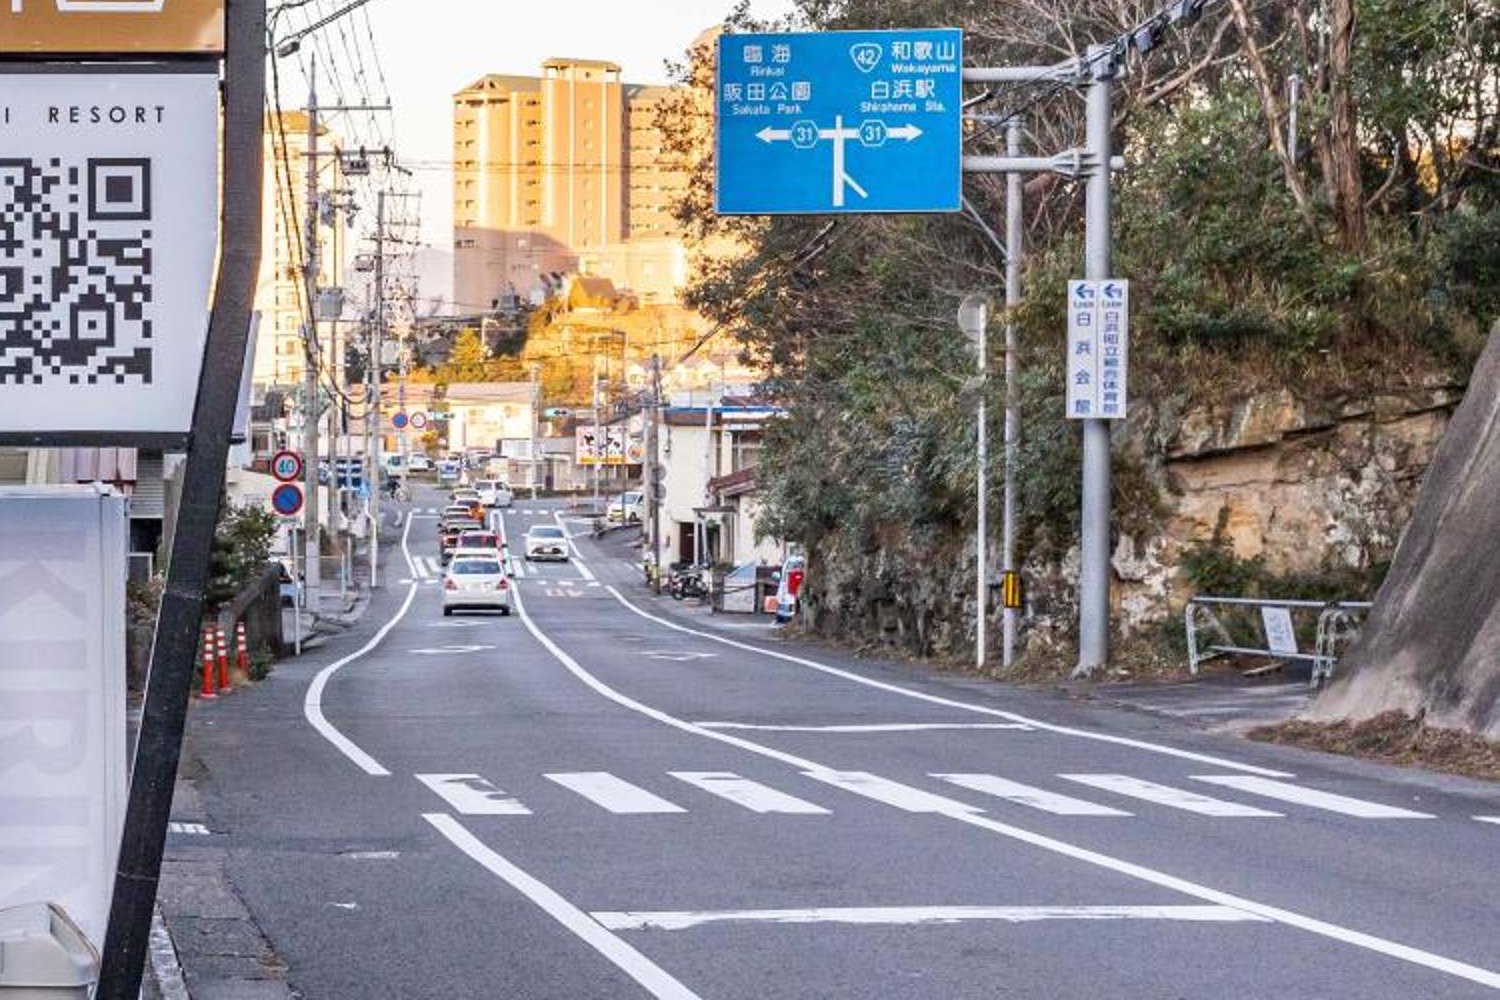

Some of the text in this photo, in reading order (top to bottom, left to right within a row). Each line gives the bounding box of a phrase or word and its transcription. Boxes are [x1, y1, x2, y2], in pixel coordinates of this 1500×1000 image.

[857, 48, 876, 65] 42
[891, 40, 956, 60] 和歌山
[891, 62, 957, 74] Wakayama
[871, 79, 936, 99] 白浜駅
[49, 106, 166, 124] RESORT
[777, 103, 803, 115] Park
[797, 127, 813, 142] 31
[865, 126, 882, 141] 31
[278, 460, 296, 473] 40
